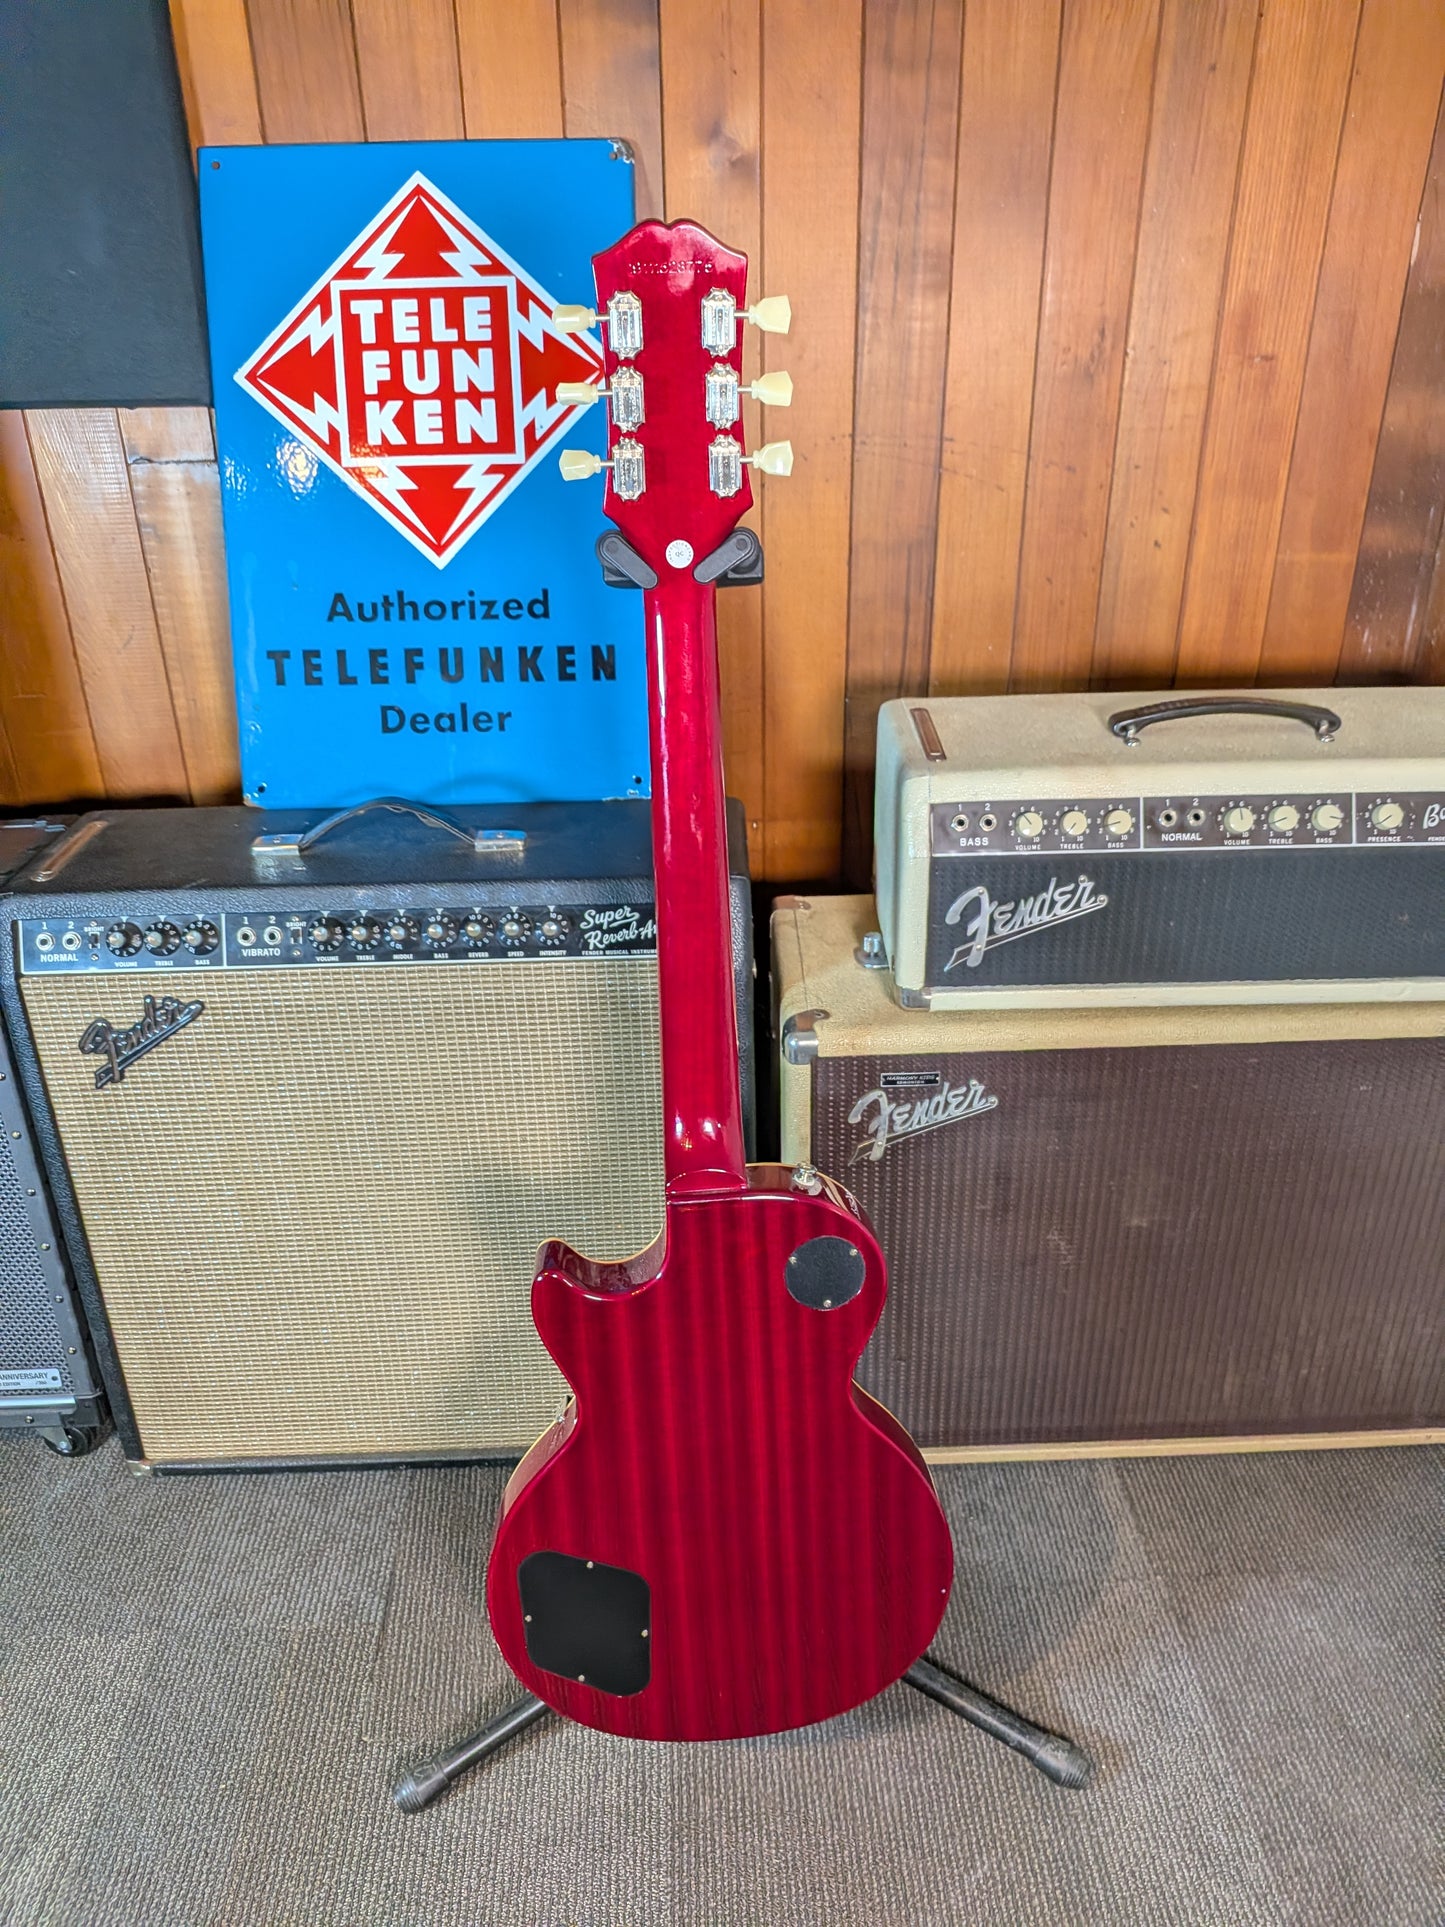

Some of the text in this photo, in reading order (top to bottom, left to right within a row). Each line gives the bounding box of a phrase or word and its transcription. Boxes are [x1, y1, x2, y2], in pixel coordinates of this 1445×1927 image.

[350, 296, 492, 344] TELE
[362, 347, 495, 395] FUN
[365, 398, 498, 446] KEN
[326, 588, 551, 623] Authorized
[266, 644, 618, 687] TELEFUNKEN
[380, 702, 512, 734] Dealer
[1192, 797, 1199, 806] 2
[958, 803, 962, 811] 1
[984, 803, 991, 811] 2
[960, 838, 988, 846] BASS
[1162, 832, 1202, 842] NORMAL
[242, 916, 249, 925] 1
[268, 915, 276, 924] 2
[580, 905, 640, 930] Super
[944, 875, 1108, 970] Fender
[42, 922, 48, 930] 1
[68, 921, 74, 929] 2
[242, 948, 280, 956] VIBRATO
[40, 954, 78, 962] NORMAL
[79, 995, 204, 1088] Fender
[848, 1079, 999, 1166] Fender
